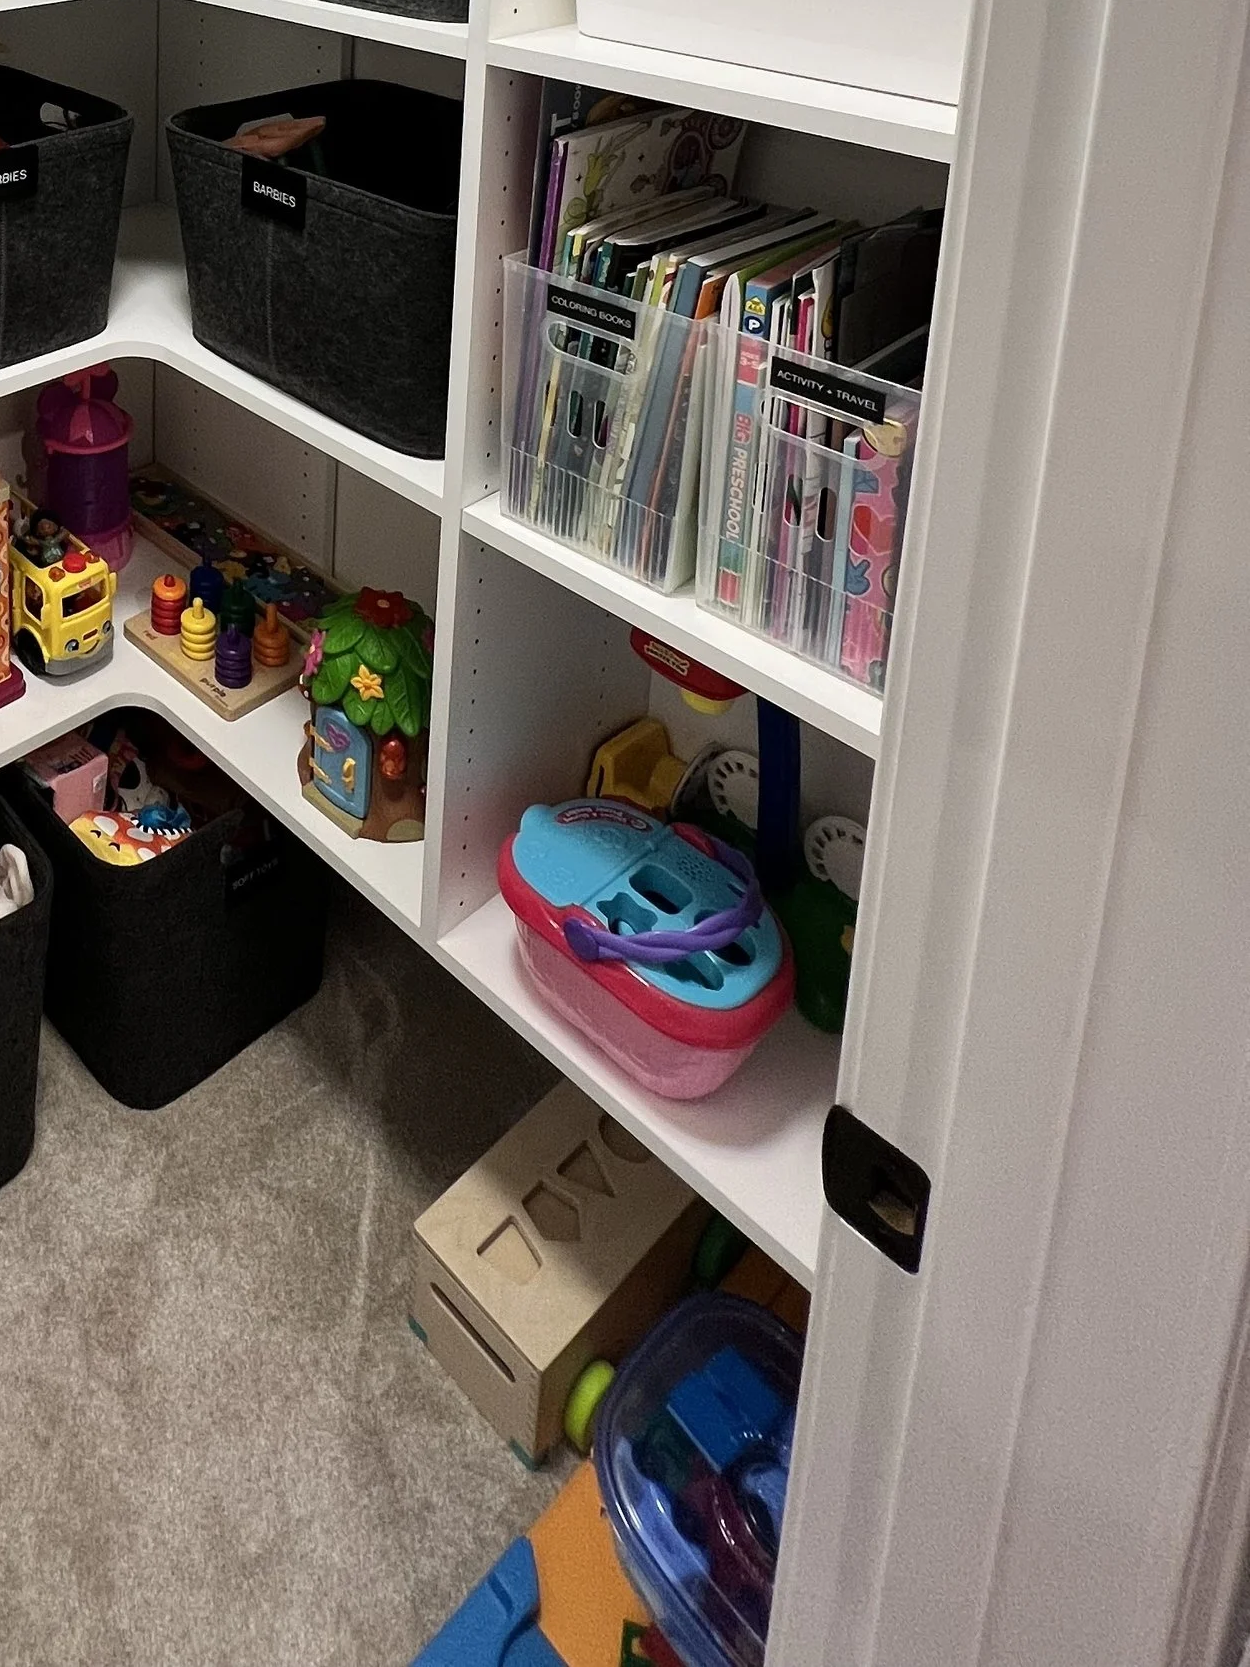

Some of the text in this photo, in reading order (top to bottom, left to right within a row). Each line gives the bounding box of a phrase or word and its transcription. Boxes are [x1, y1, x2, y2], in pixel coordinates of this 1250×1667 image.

[252, 180, 297, 209] BARBIES
[550, 292, 633, 331] COLORING BOOKS
[776, 367, 825, 395] ACTIVITY
[835, 389, 879, 413] TRAVEL
[735, 412, 753, 446] BIG
[723, 446, 749, 541] PRESCHOOL
[199, 677, 227, 698] purple
